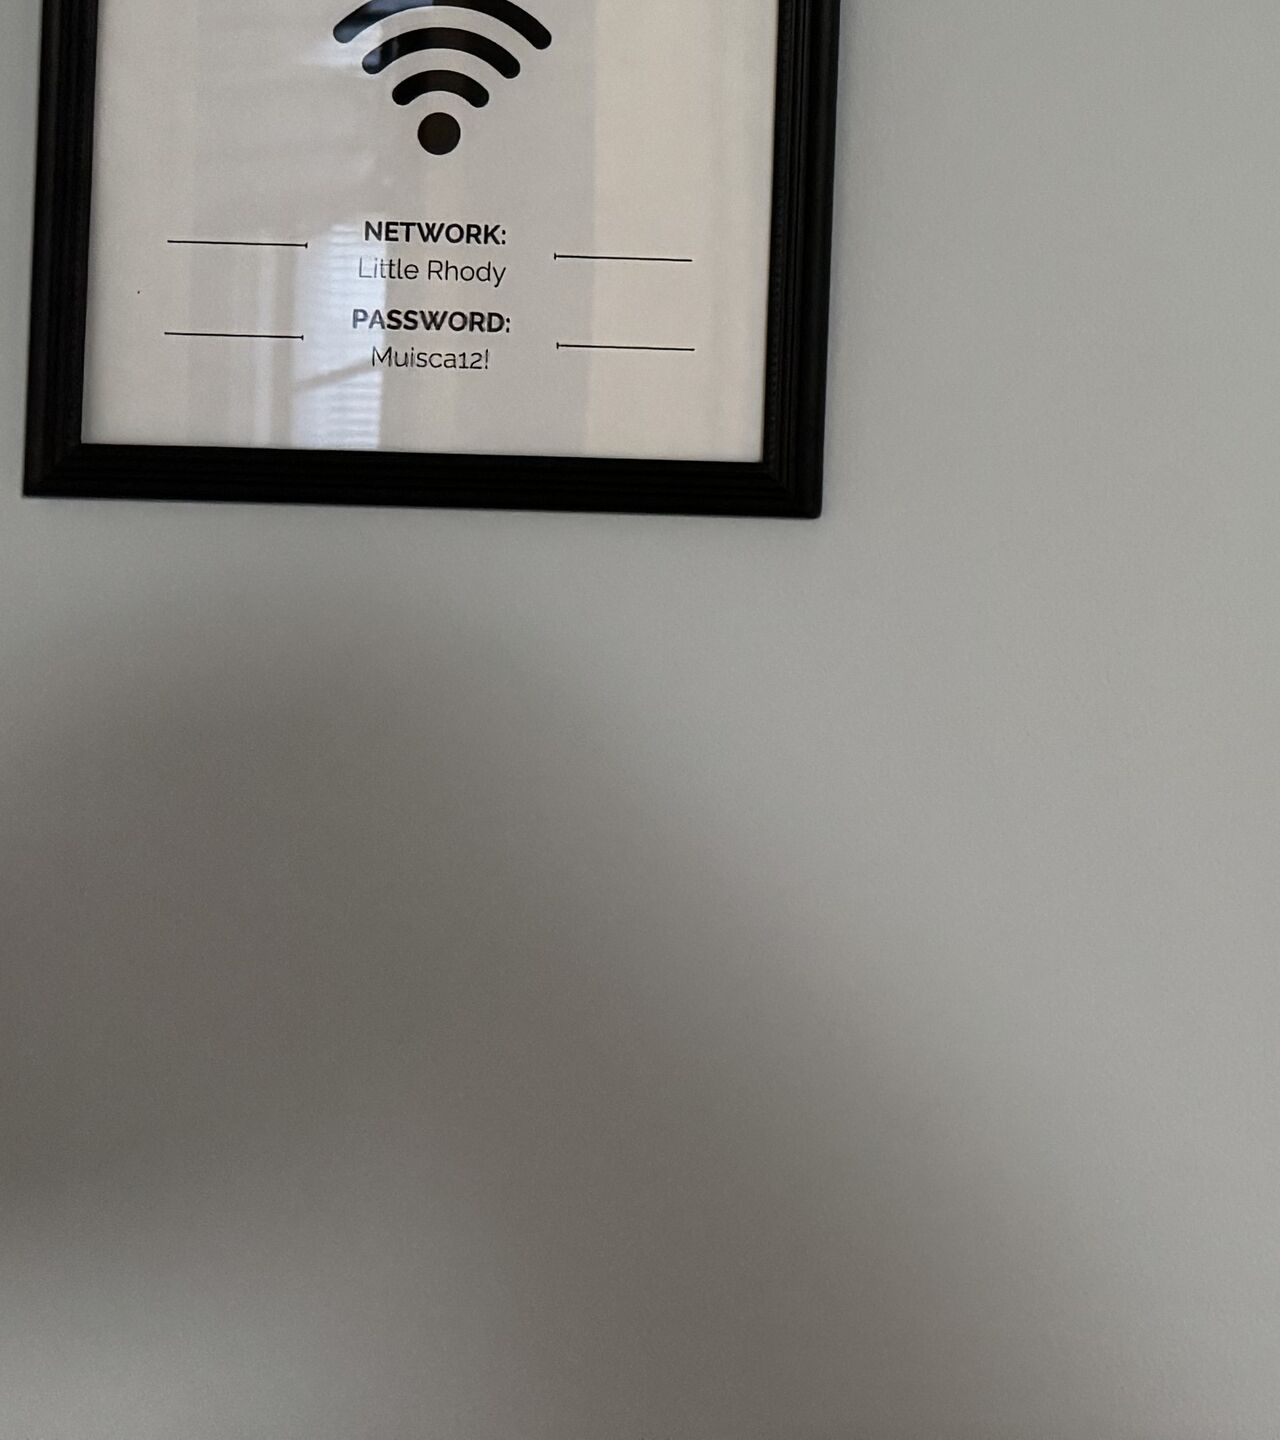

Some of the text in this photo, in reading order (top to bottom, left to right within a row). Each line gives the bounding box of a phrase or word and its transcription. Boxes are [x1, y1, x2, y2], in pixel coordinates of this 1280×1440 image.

[364, 220, 506, 245] NETWORK:
[358, 257, 506, 288] Little Rhody
[352, 308, 510, 333] PASSWORD:
[371, 346, 489, 370] Muisca12!
